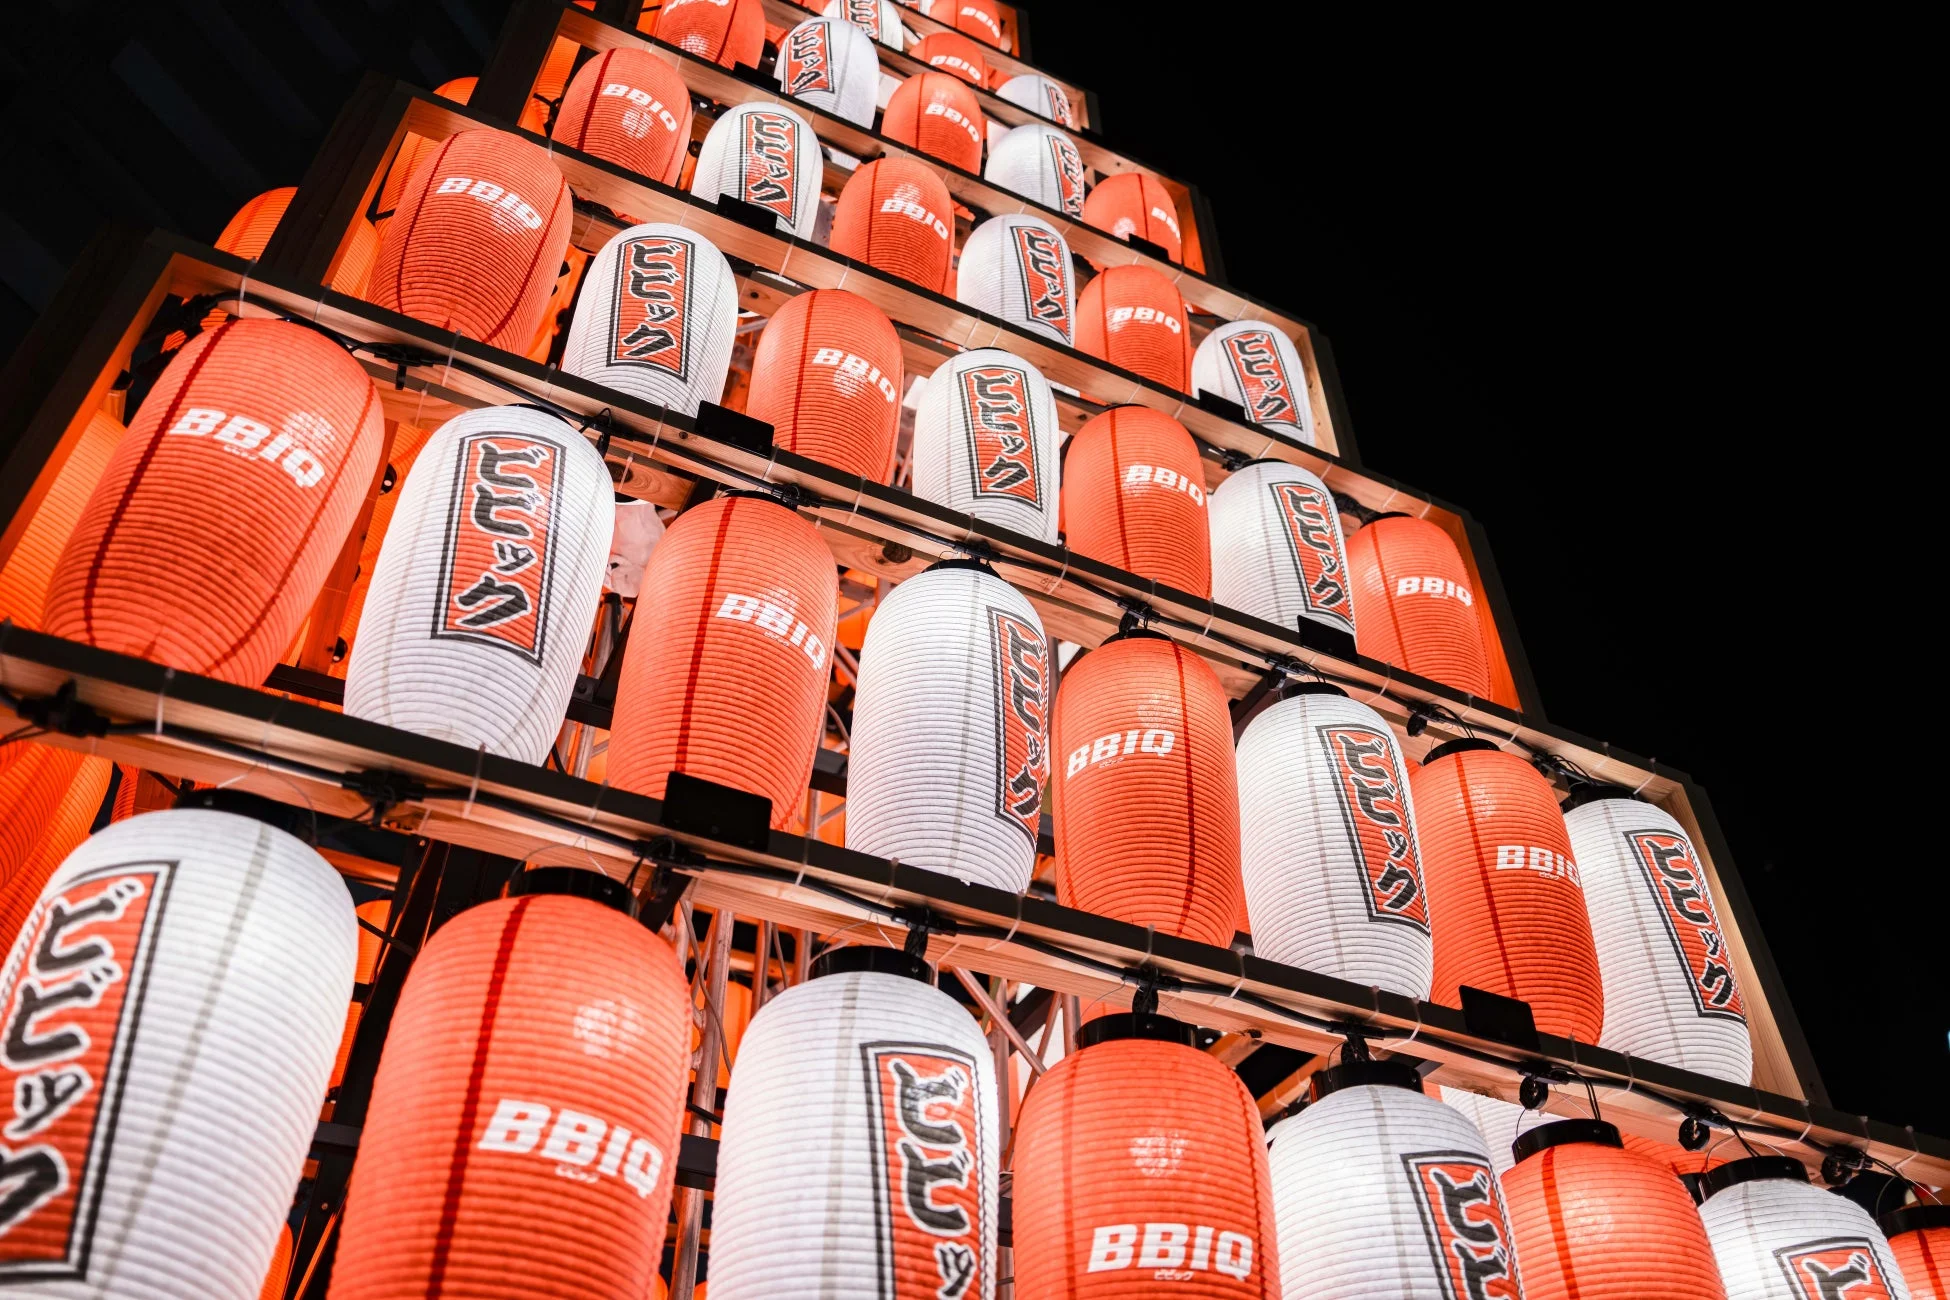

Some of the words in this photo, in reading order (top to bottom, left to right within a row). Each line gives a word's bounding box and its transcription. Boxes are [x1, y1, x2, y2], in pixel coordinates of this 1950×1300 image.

[960, 6, 1000, 38] BBIQ
[930, 55, 982, 80] BBIQ
[602, 83, 677, 132] BBIQ
[925, 102, 980, 142] BBIQ
[749, 114, 790, 203] ビビック
[436, 177, 542, 230] BBIQ
[881, 198, 949, 240] BBIQ
[622, 243, 683, 357] ビビック
[1024, 231, 1063, 320] ビビック
[1111, 306, 1181, 334] BBIQ
[812, 348, 896, 403] BBIQ
[1233, 333, 1289, 420] ビビック
[169, 407, 326, 488] BBIQ
[972, 372, 1030, 490] ビビック
[1126, 465, 1204, 507] BBIQ
[453, 440, 550, 629] ビビック
[1284, 486, 1345, 608] ビビック
[1396, 576, 1473, 607] BBIQ
[715, 593, 826, 670] BBIQ
[1005, 619, 1045, 819] ビビック
[1066, 729, 1176, 780] BBIQ
[1337, 733, 1419, 912] ビビック
[1644, 834, 1735, 1008] ビビック
[477, 1098, 664, 1200] BBIQ
[1087, 1222, 1253, 1282] BBIQ
[1153, 1269, 1194, 1281] ビビック
